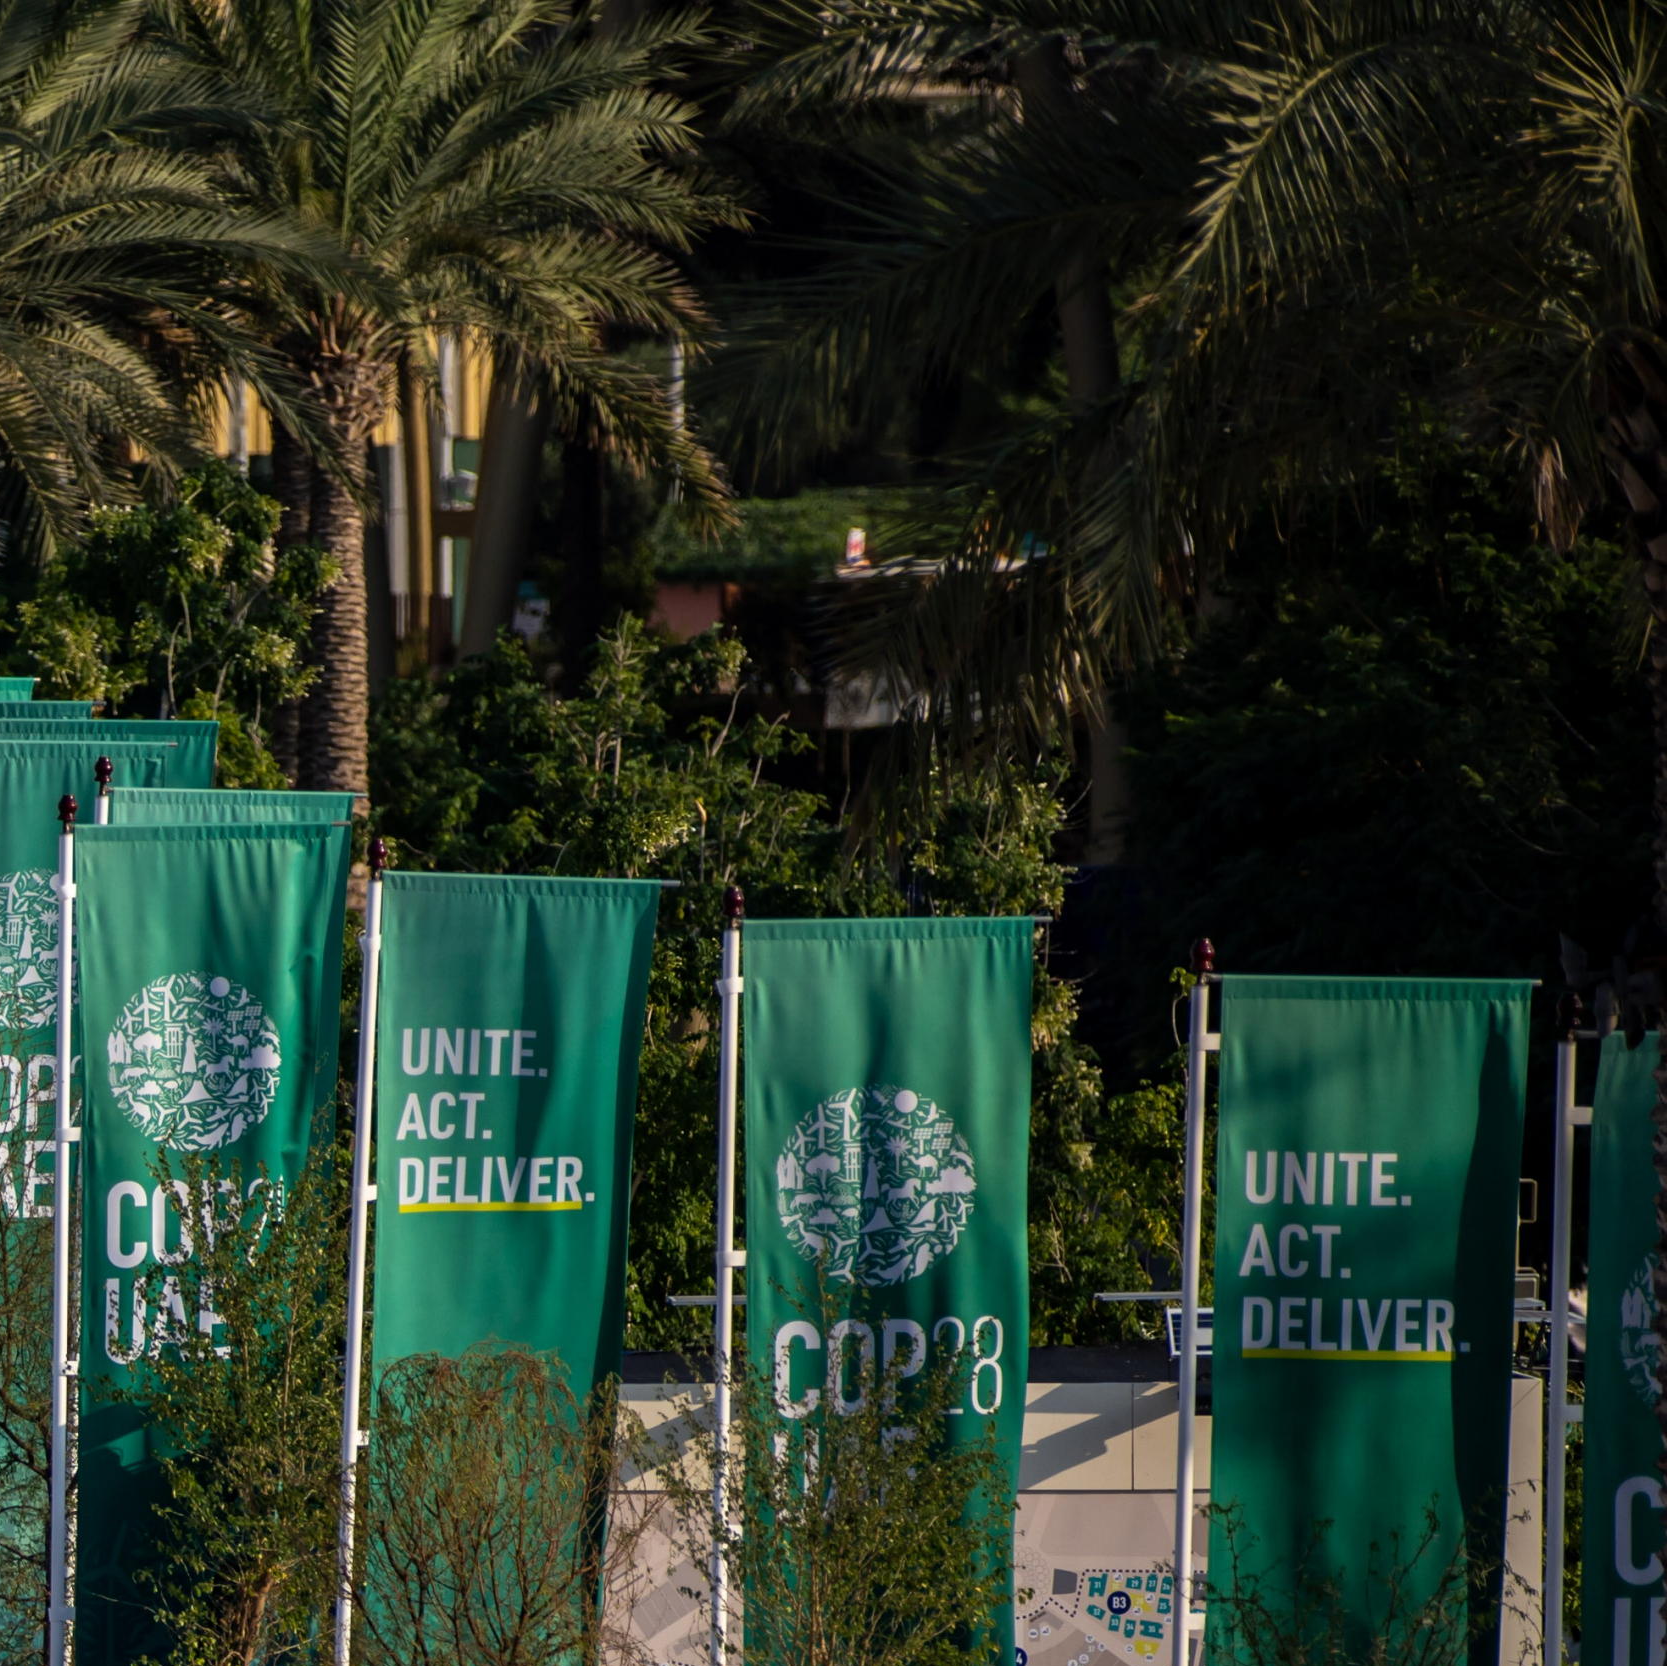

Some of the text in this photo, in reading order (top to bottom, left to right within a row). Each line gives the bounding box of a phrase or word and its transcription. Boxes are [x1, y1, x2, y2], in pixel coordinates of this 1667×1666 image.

[401, 1027, 548, 1078] UNITE.
[396, 1091, 492, 1141] ACT.
[398, 1155, 595, 1205] DELIVER.
[1244, 1150, 1412, 1207] UNITE.
[1238, 1223, 1351, 1279] ACT.
[1241, 1296, 1471, 1353] DELIVER.
[1112, 1596, 1127, 1609] B3
